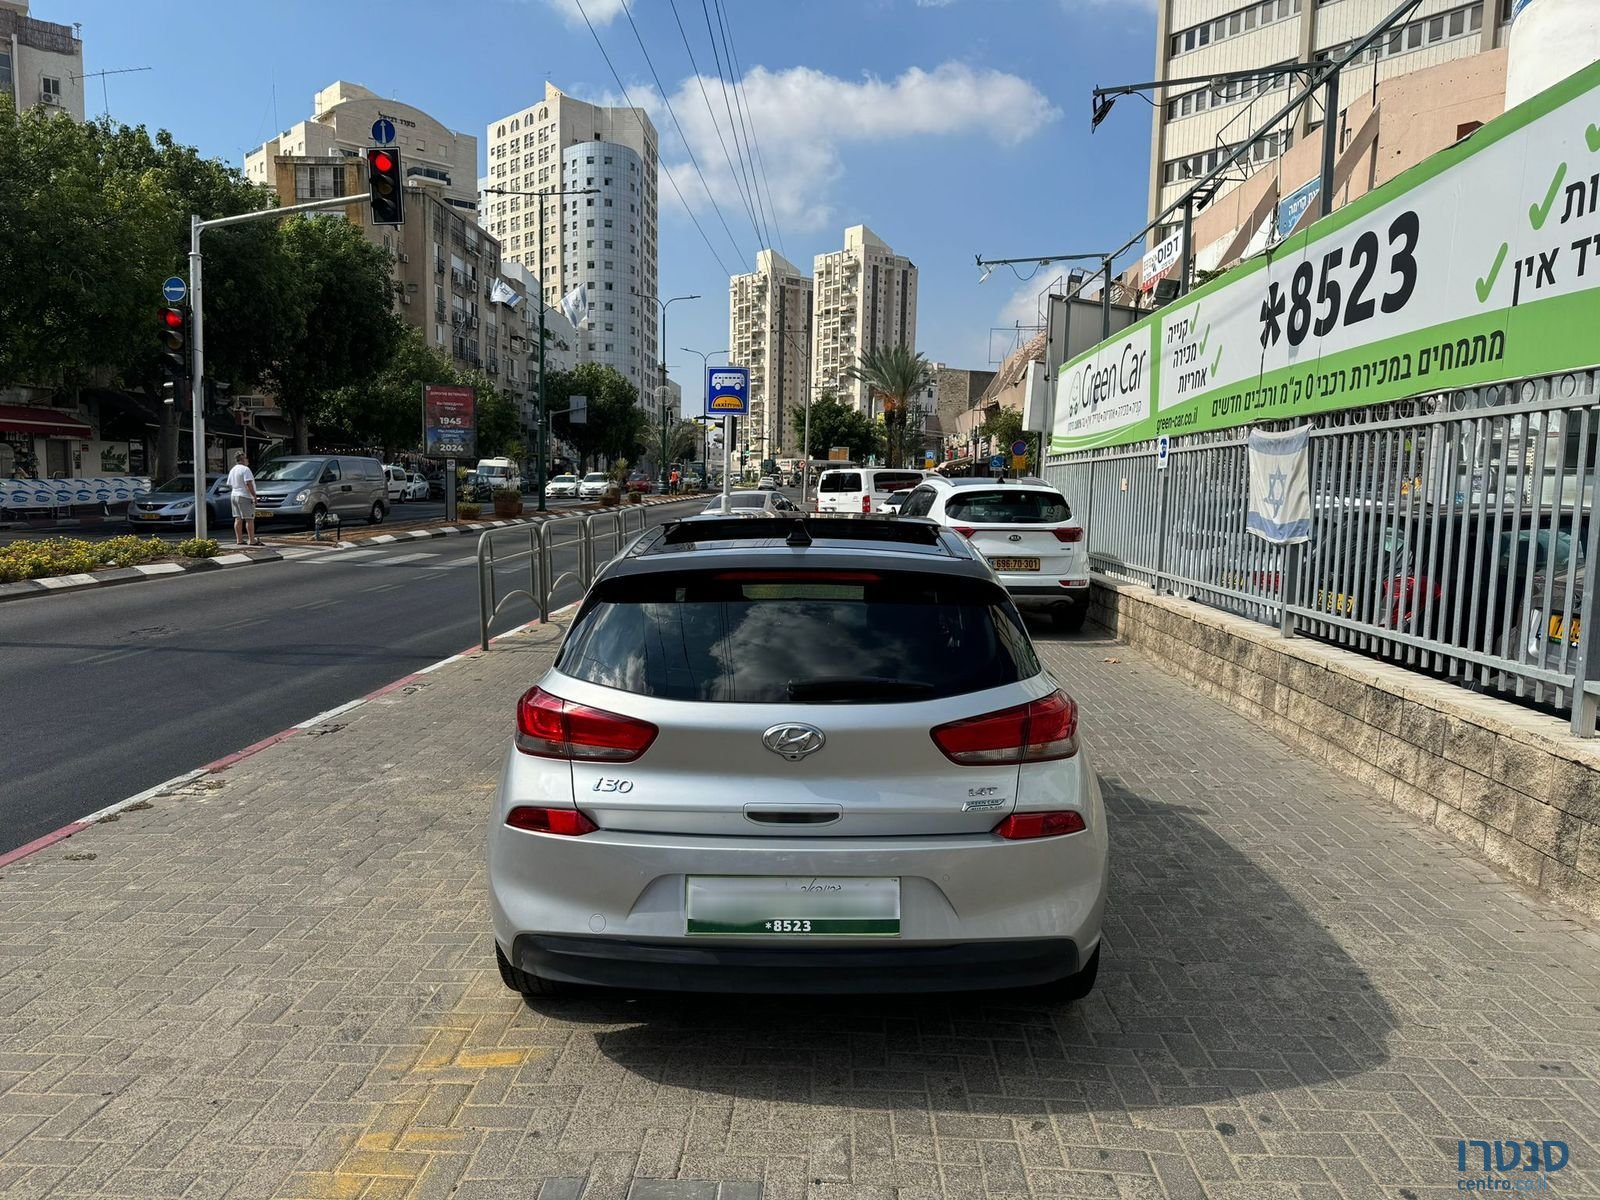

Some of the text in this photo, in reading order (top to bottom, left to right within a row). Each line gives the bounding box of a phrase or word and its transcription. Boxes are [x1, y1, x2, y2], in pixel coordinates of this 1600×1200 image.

[1157, 236, 1179, 264] דפוס
[1512, 247, 1560, 307] אין
[1167, 319, 1189, 344] קנייה
[1172, 342, 1197, 368] מכירה
[1418, 329, 1505, 376] מתמחים
[1081, 343, 1146, 408] Green Car
[1177, 367, 1208, 394] אחריות
[1317, 370, 1346, 397] רכבי
[1349, 353, 1412, 391] במכירת
[1244, 384, 1278, 410] ורכבים
[1305, 373, 1314, 399] 0
[1211, 394, 1242, 417] חדשים
[440, 417, 462, 425] 1945
[1156, 406, 1199, 434] green-car.co.il
[440, 444, 464, 452] 2024
[592, 777, 634, 794] i30
